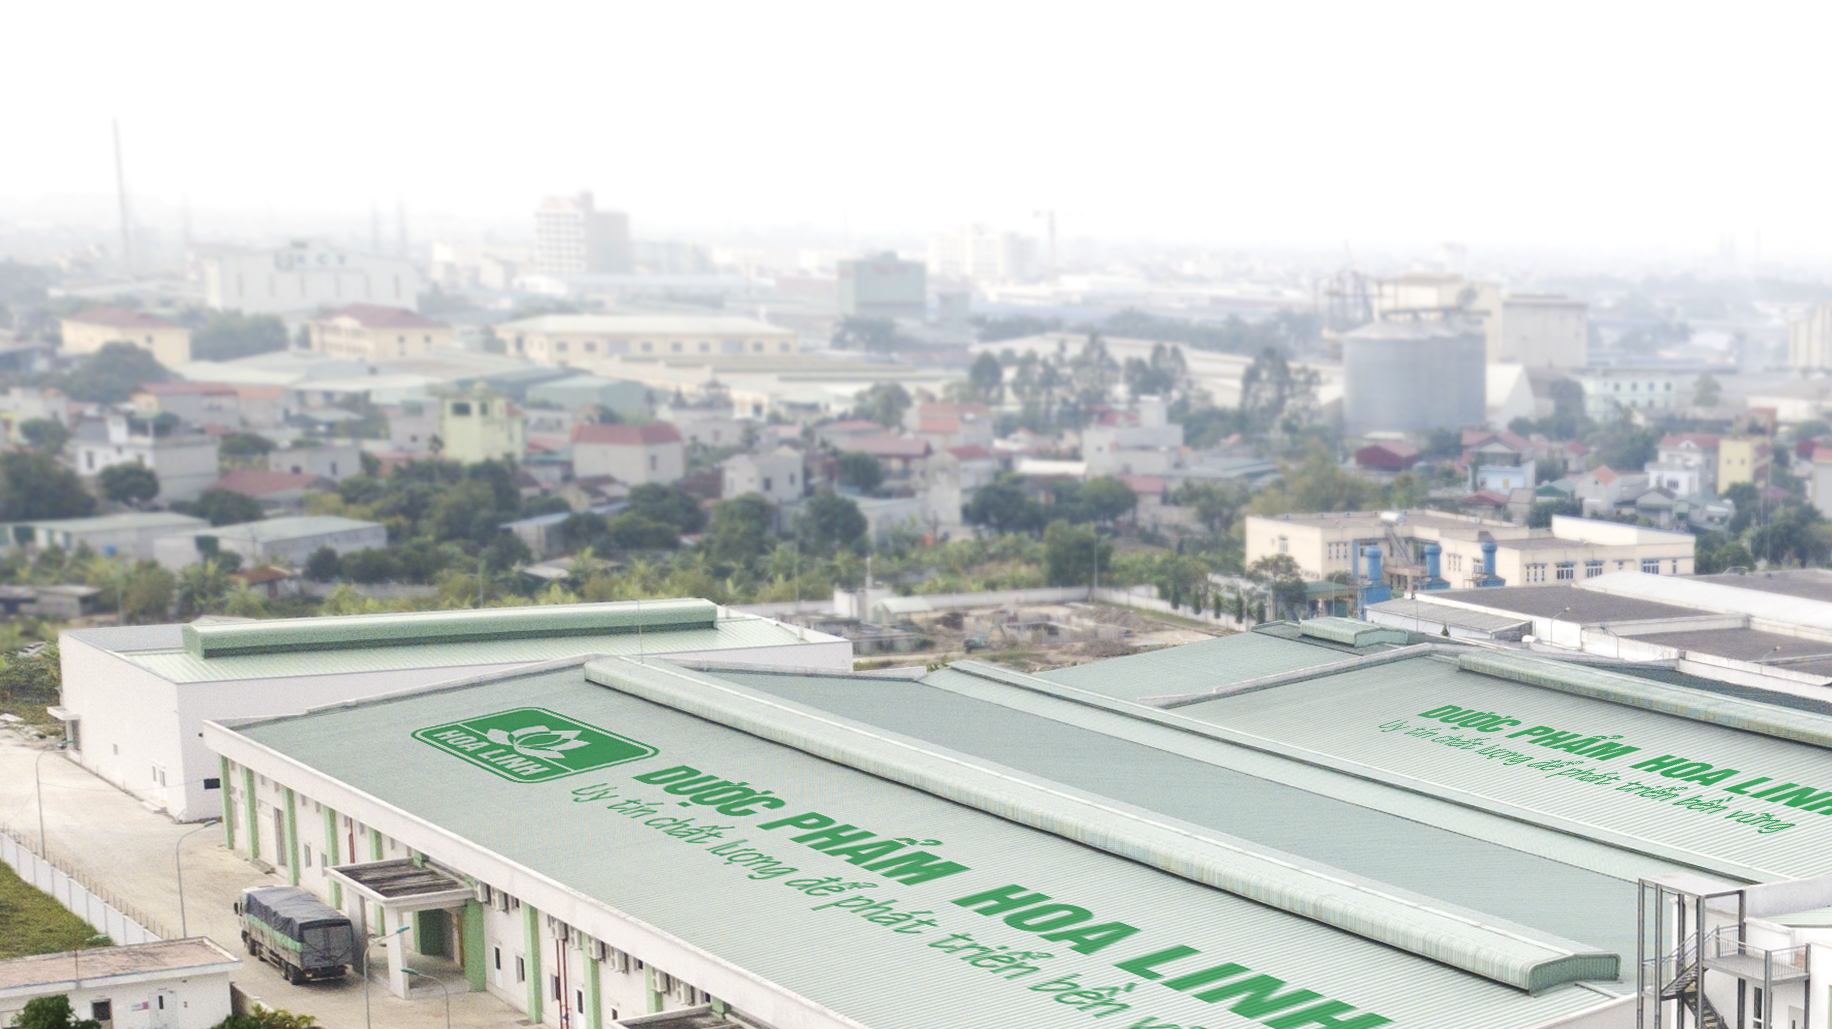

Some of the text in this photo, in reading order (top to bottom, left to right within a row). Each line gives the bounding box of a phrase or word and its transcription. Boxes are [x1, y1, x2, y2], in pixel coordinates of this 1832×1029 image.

[431, 730, 551, 776] HOA LINH
[1417, 705, 1522, 733] DƯỢC
[1505, 726, 1642, 761] PHẨM
[1628, 755, 1741, 787] HOA
[571, 783, 619, 802] Uy
[1379, 719, 1796, 834] Uy tín chất lượng để phát triển bền vững
[606, 799, 664, 819] tín
[644, 817, 736, 844] chất
[632, 765, 786, 817] DƯỢC
[756, 812, 973, 887] PHẨM
[949, 884, 1143, 955] HOA
[705, 839, 799, 880] lượng
[784, 876, 879, 896] để
[810, 896, 939, 934] phát
[927, 933, 1055, 980] triển
[1027, 973, 1139, 1019] bền
